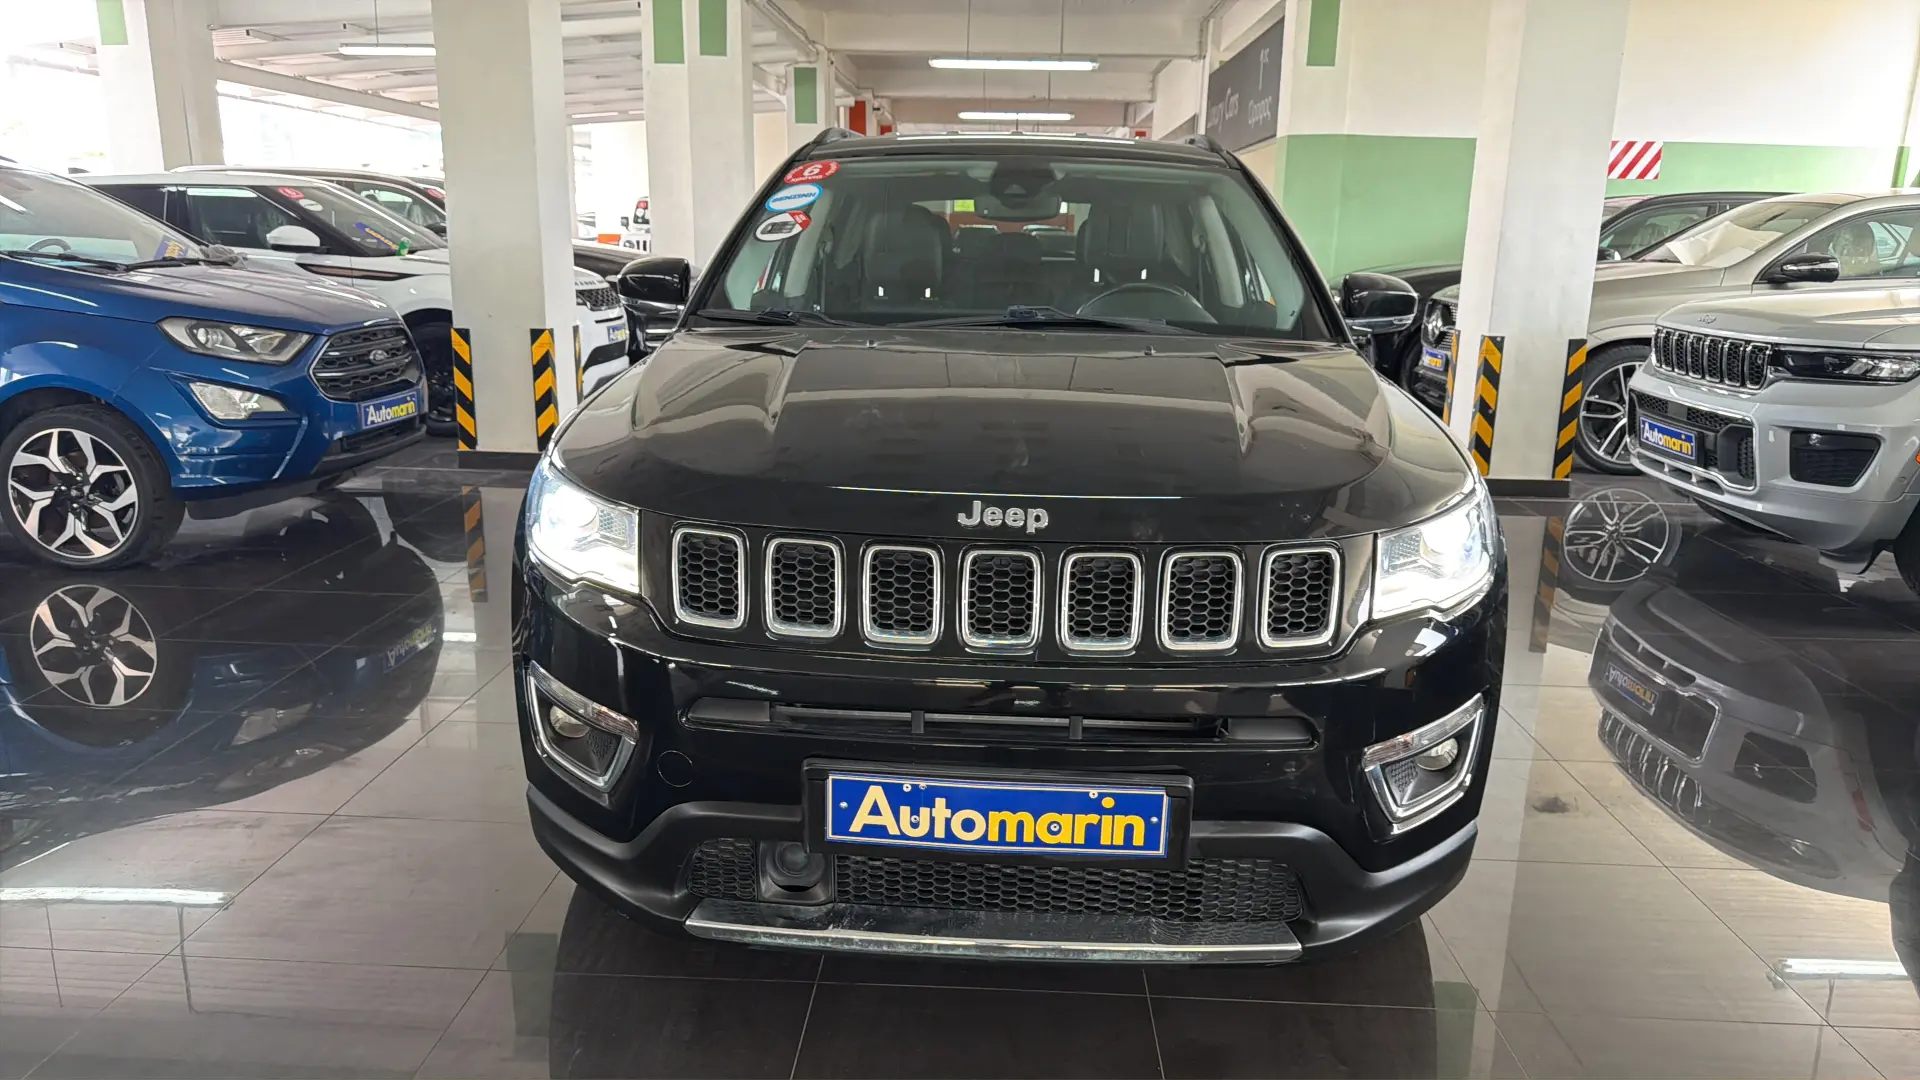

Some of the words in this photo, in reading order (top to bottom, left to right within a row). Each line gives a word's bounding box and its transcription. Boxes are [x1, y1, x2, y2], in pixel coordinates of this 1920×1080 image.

[803, 164, 823, 177] 6
[366, 396, 416, 425] Automarin
[1643, 421, 1693, 456] Automarin
[957, 500, 1049, 535] Jeep
[848, 784, 1146, 847] Automarin
